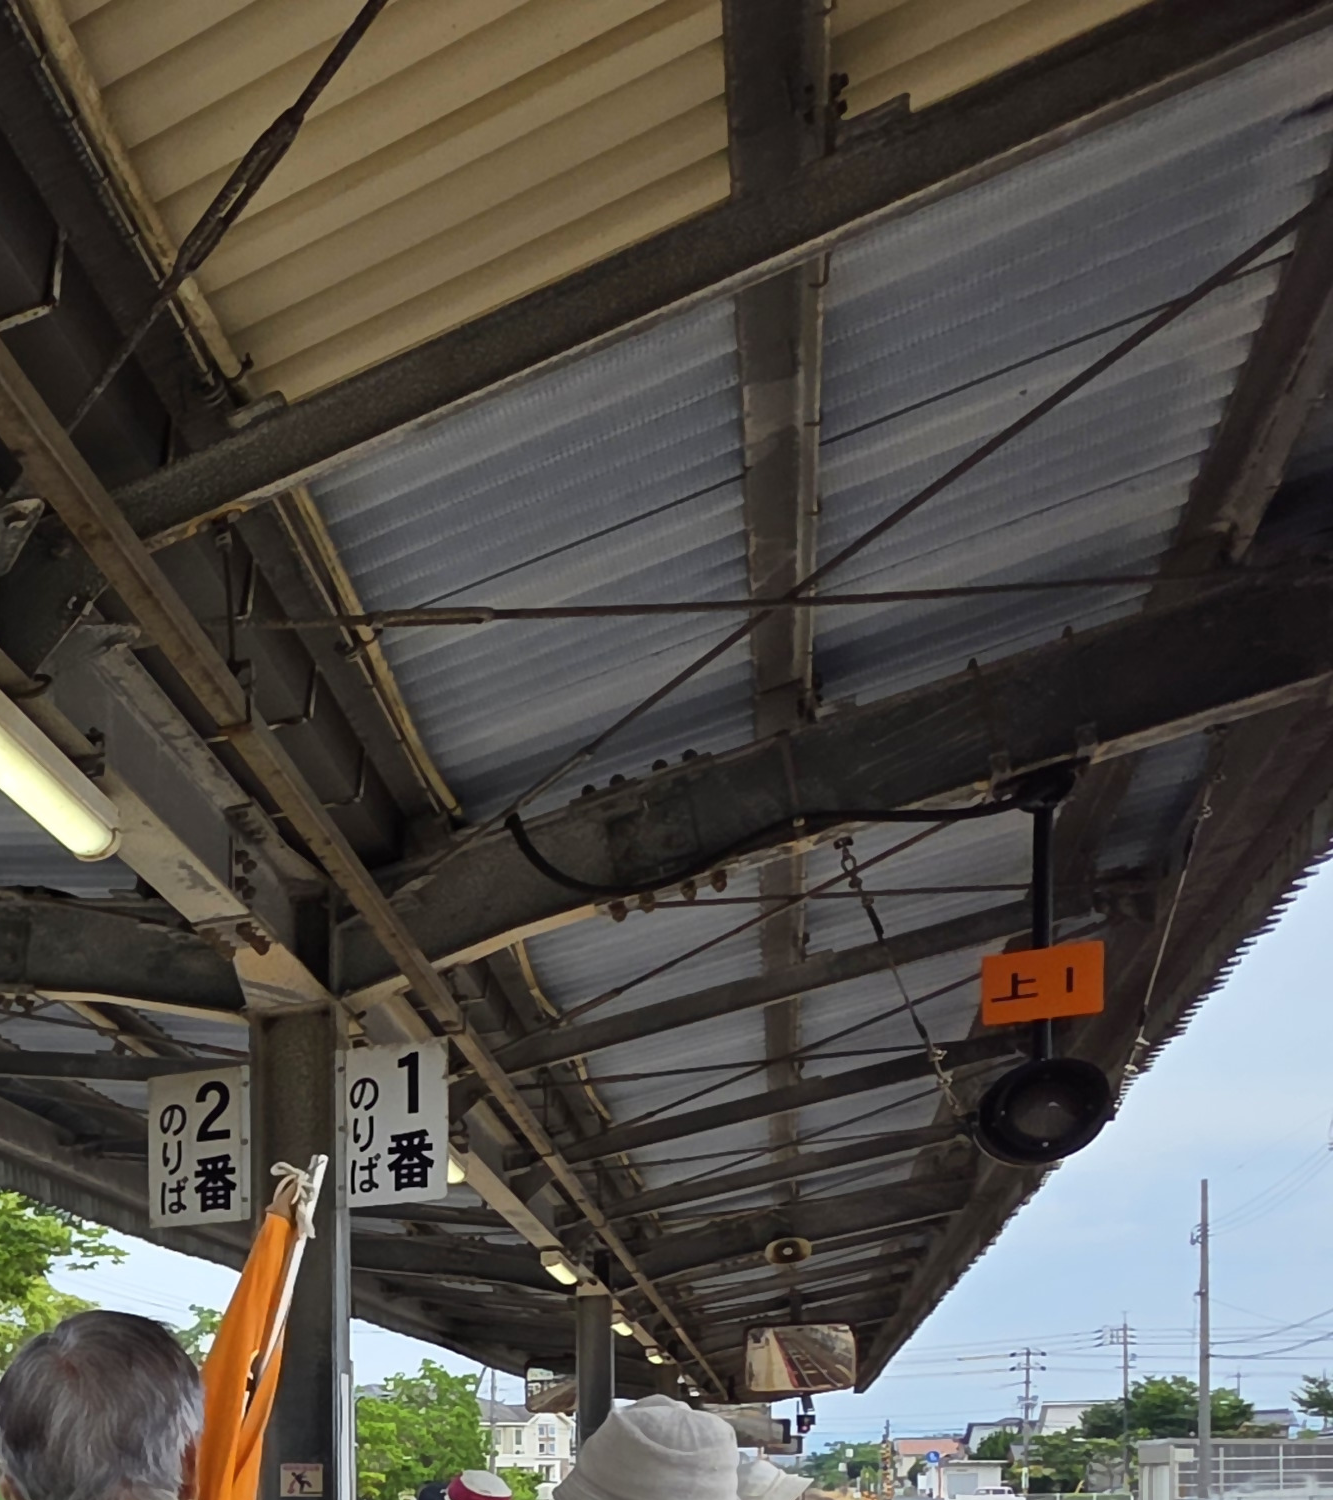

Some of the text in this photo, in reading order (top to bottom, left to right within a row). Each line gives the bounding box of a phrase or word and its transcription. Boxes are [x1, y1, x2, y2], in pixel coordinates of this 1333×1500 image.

[160, 1104, 189, 1215] のりば
[194, 1081, 237, 1213] 2番
[349, 1077, 381, 1195] のりば
[387, 1051, 435, 1192] 1番
